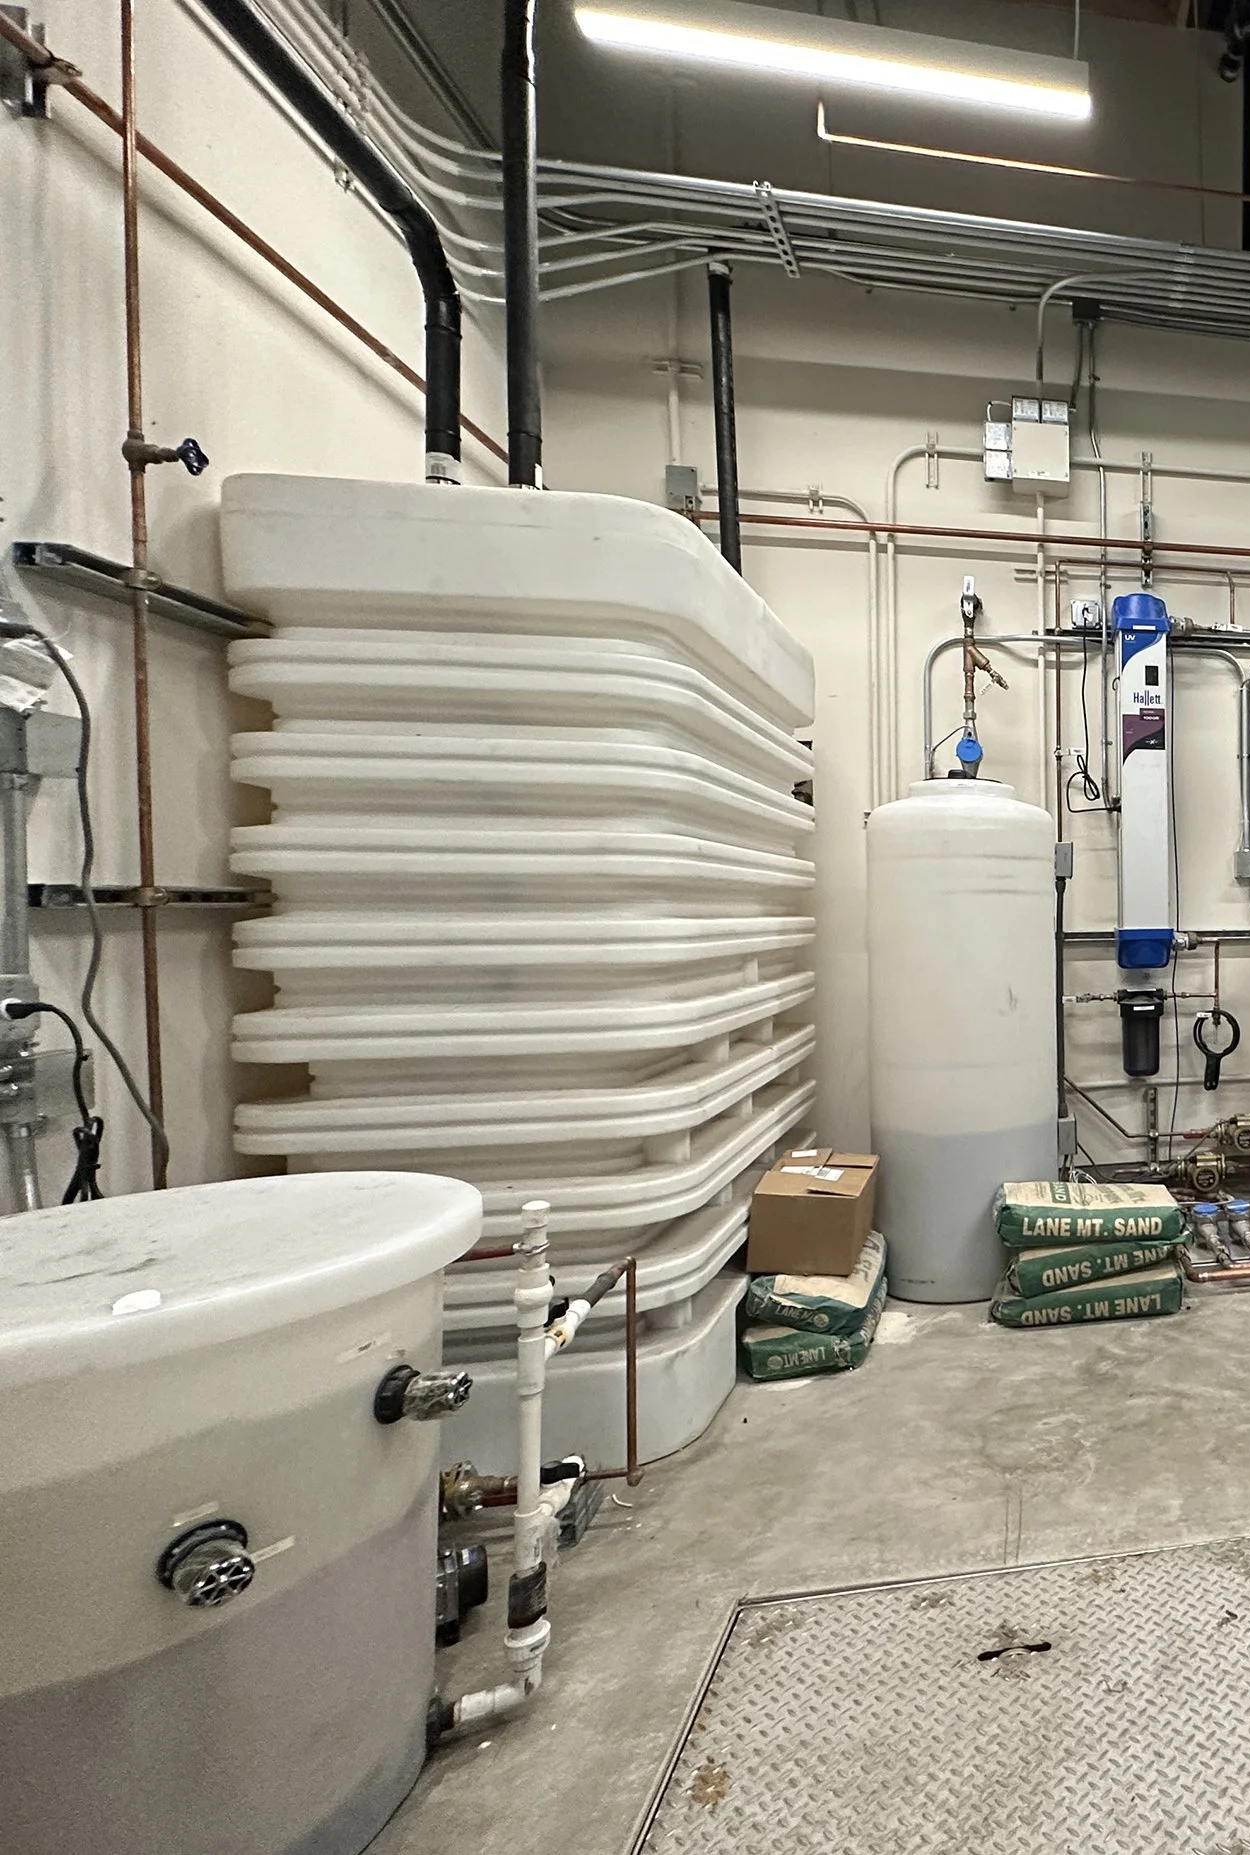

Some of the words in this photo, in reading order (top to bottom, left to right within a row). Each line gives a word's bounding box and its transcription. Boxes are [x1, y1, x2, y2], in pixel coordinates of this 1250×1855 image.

[1133, 690, 1161, 706] Hallett
[1022, 1217, 1072, 1236] LANE
[1076, 1218, 1108, 1236] MT.
[1114, 1217, 1162, 1236] SAND
[1132, 1247, 1169, 1262] ANE
[1041, 1261, 1092, 1287] SAND
[1115, 1293, 1161, 1315] LANE
[1021, 1305, 1072, 1326] SAND
[800, 1346, 826, 1365] LANE
